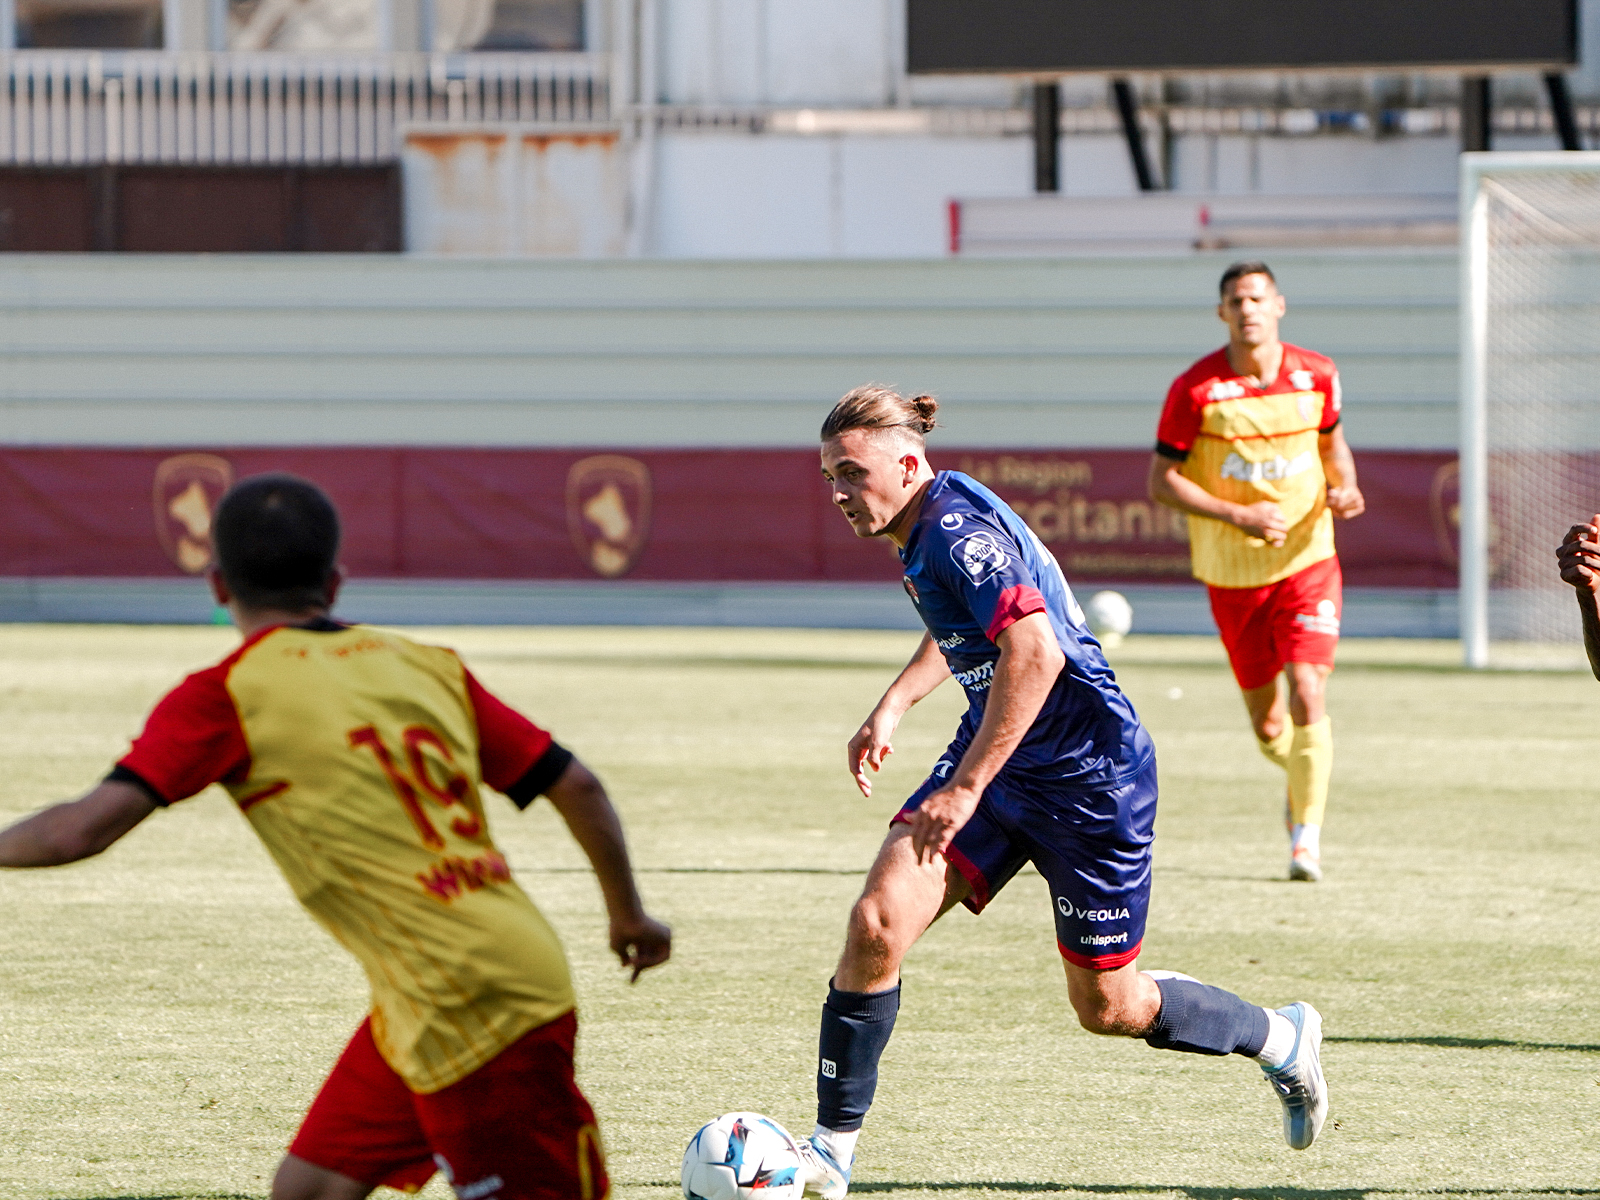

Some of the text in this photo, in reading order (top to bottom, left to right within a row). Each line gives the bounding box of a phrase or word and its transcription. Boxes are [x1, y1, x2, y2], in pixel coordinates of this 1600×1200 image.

[1220, 450, 1312, 481] Auch
[965, 543, 992, 568] SCOOP
[348, 726, 481, 849] 19
[1076, 908, 1130, 921] VEOLIA
[1080, 931, 1128, 946] uhlsport
[823, 1061, 835, 1075] 28
